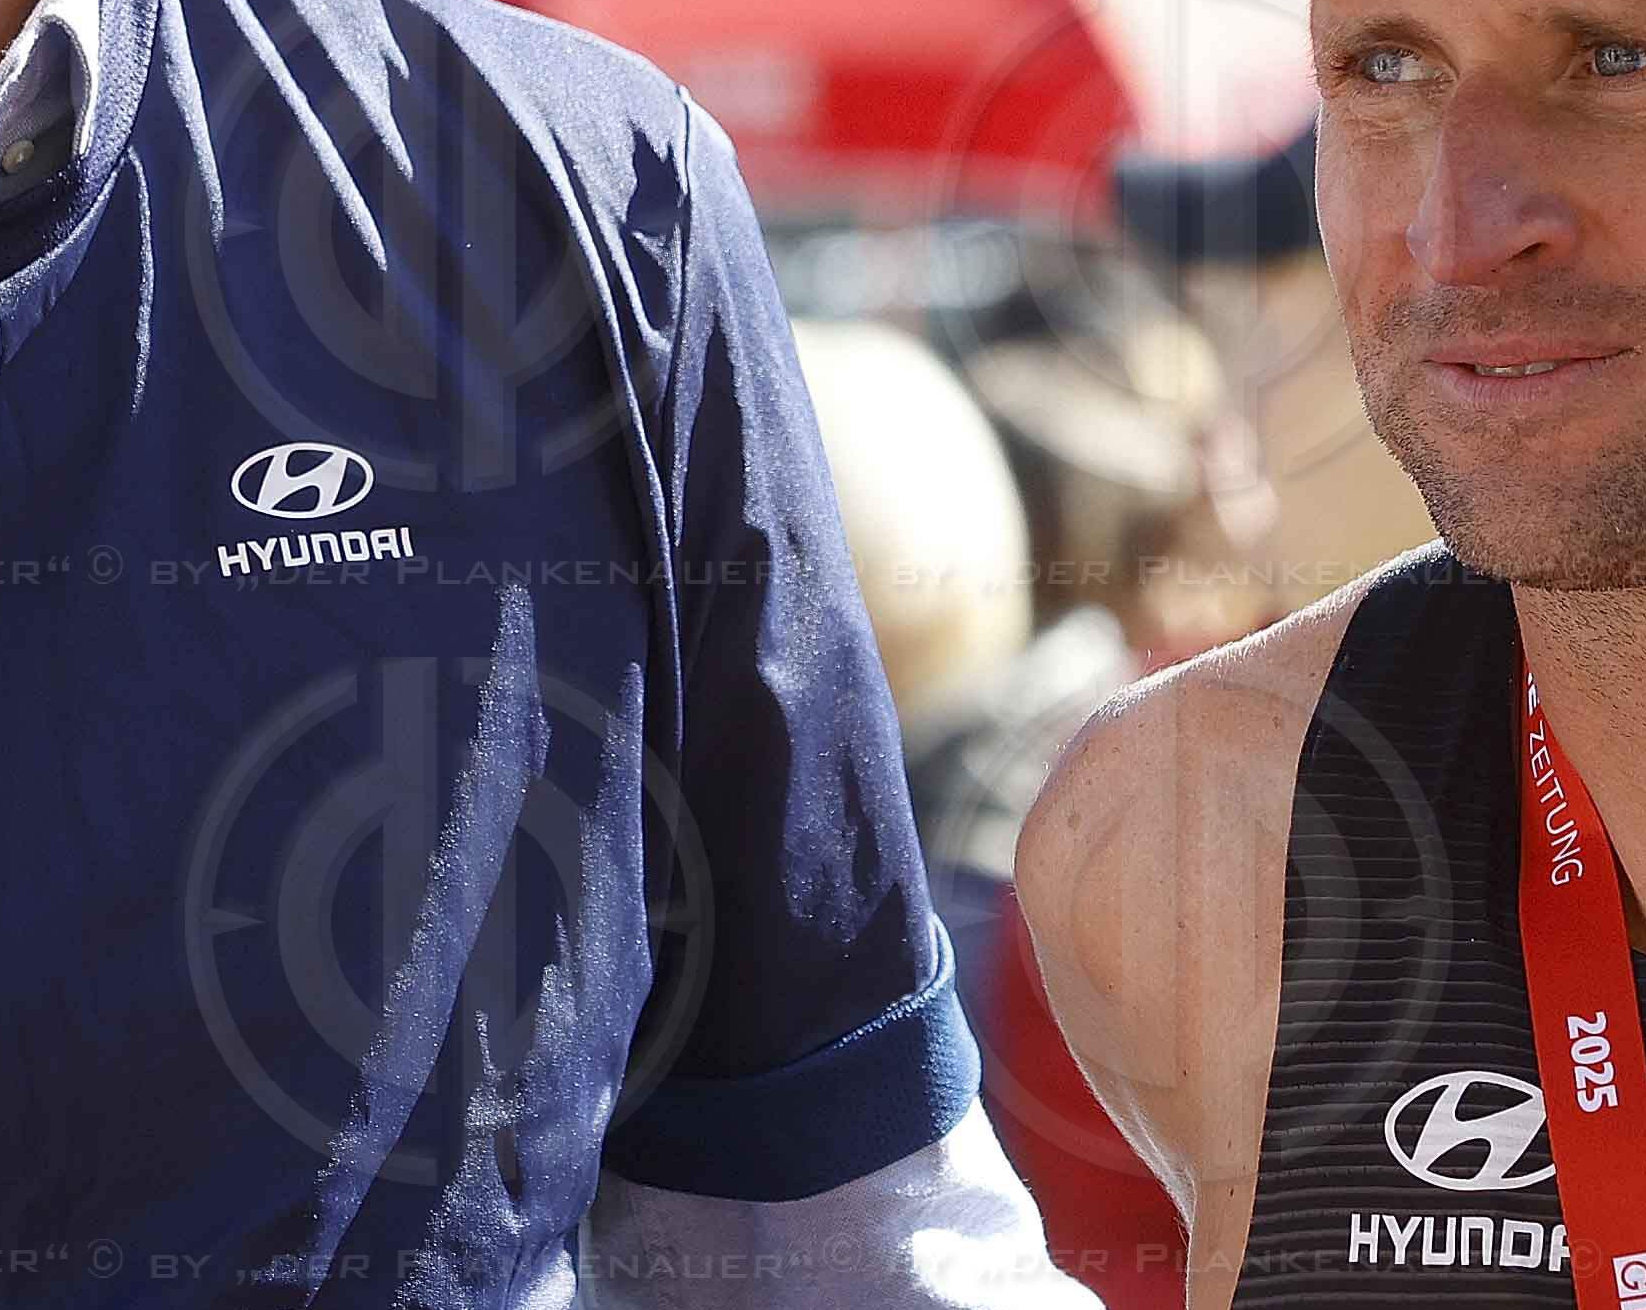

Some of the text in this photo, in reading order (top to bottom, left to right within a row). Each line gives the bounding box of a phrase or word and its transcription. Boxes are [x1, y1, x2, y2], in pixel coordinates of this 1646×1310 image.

[217, 527, 414, 577] HYUNDAI
[1529, 720, 1584, 886] ZEITUNG
[1566, 1011, 1619, 1113] 2025
[1349, 1213, 1570, 1272] HYUNDA
